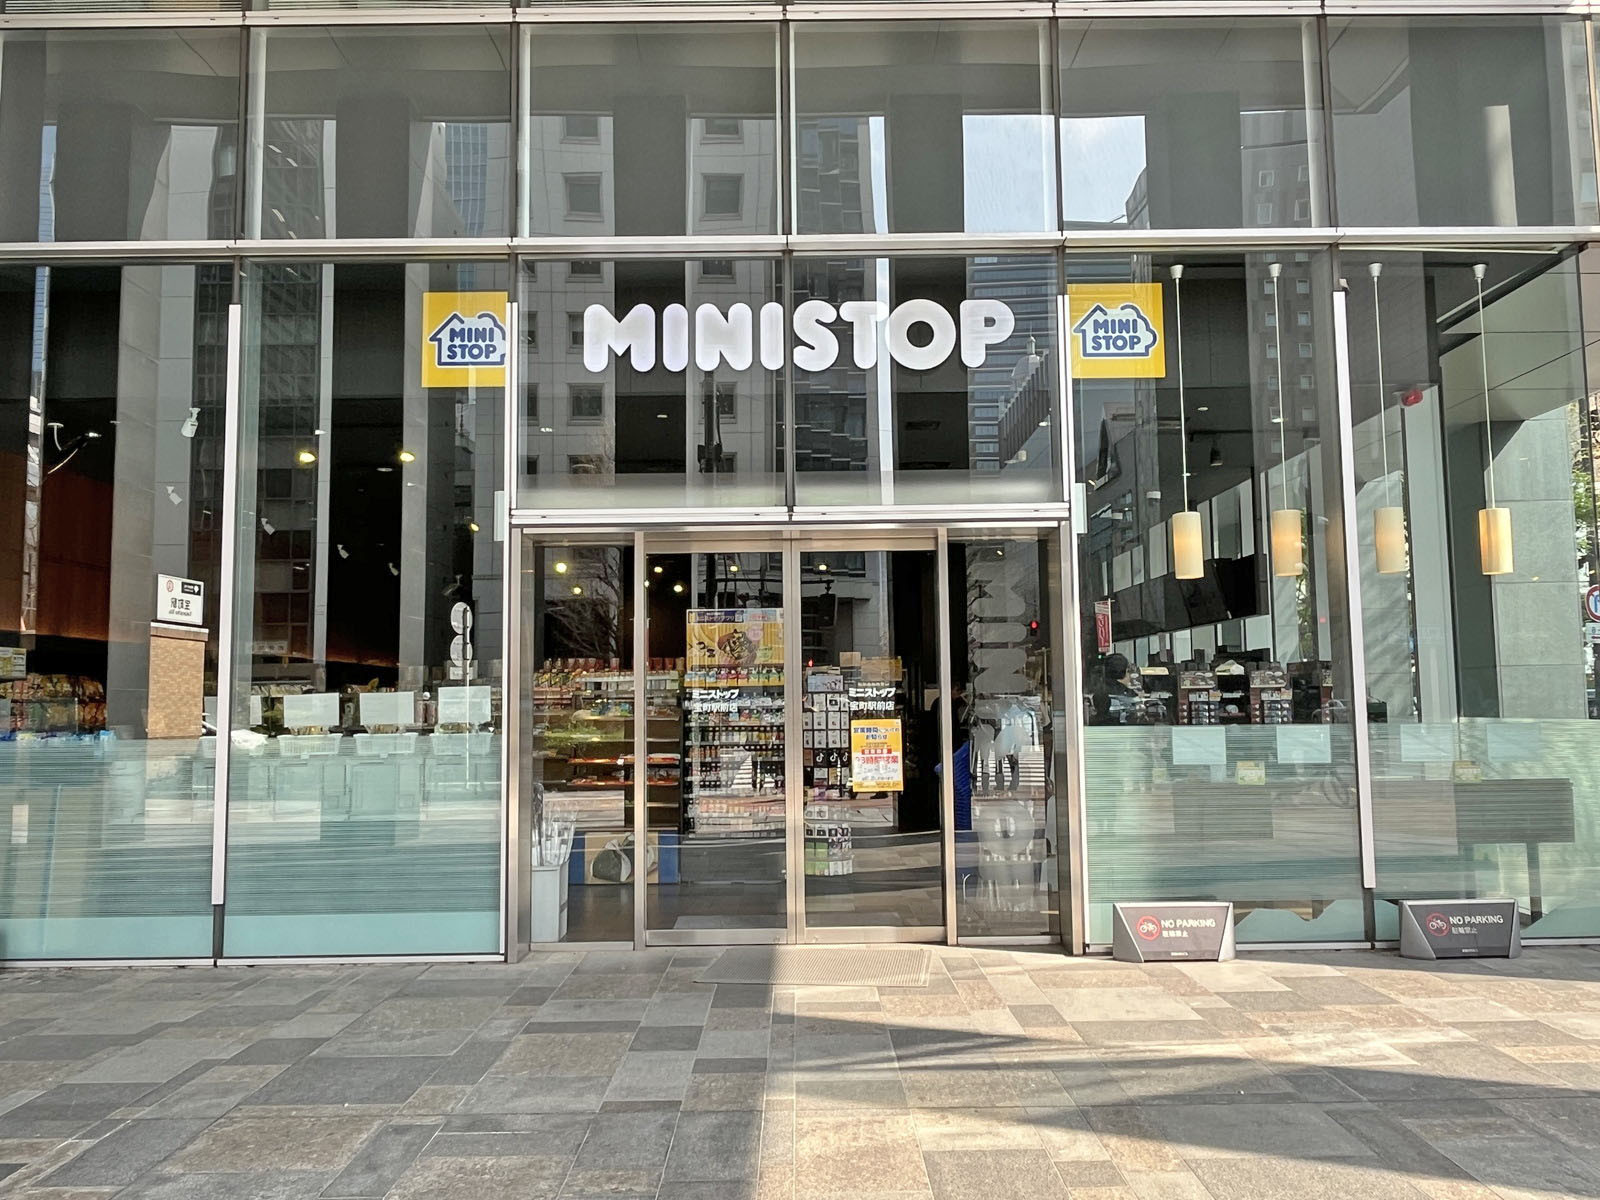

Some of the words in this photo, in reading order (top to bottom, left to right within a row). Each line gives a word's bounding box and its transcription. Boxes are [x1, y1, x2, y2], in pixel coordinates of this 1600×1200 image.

[1093, 318, 1138, 334] MINI
[449, 327, 495, 343] MINI
[583, 299, 1016, 373] MINISTOP
[1091, 335, 1142, 351] STOP
[446, 344, 497, 360] STOP
[692, 688, 740, 700] ミニストップ
[848, 687, 896, 698] ミニストップ
[849, 701, 895, 714] 宝町駅前店
[1161, 919, 1175, 928] NO
[1176, 918, 1216, 928] PARKING
[1449, 916, 1463, 925] NO
[1464, 915, 1504, 924] PARKING
